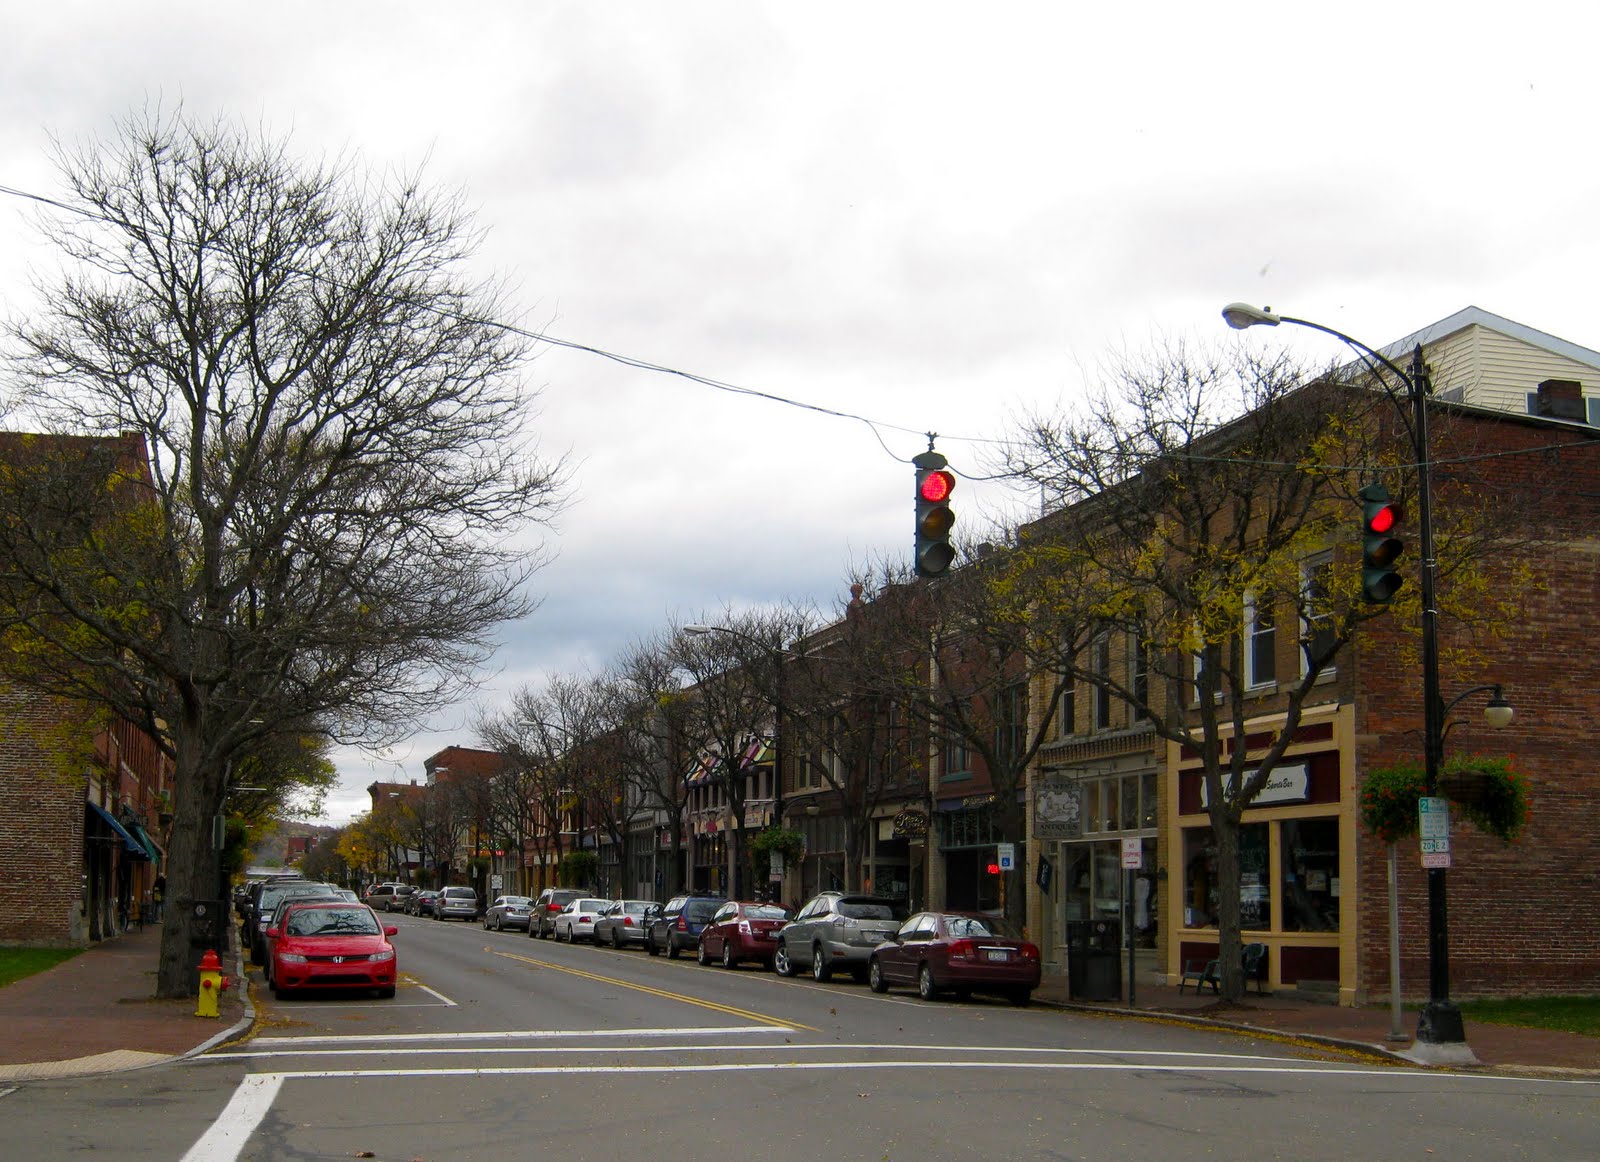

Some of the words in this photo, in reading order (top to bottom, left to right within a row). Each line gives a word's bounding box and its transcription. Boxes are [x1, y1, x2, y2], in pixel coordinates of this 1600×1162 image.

[1421, 800, 1428, 811] 2
[1423, 842, 1440, 850] ZONE
[1441, 842, 1446, 850] 2
